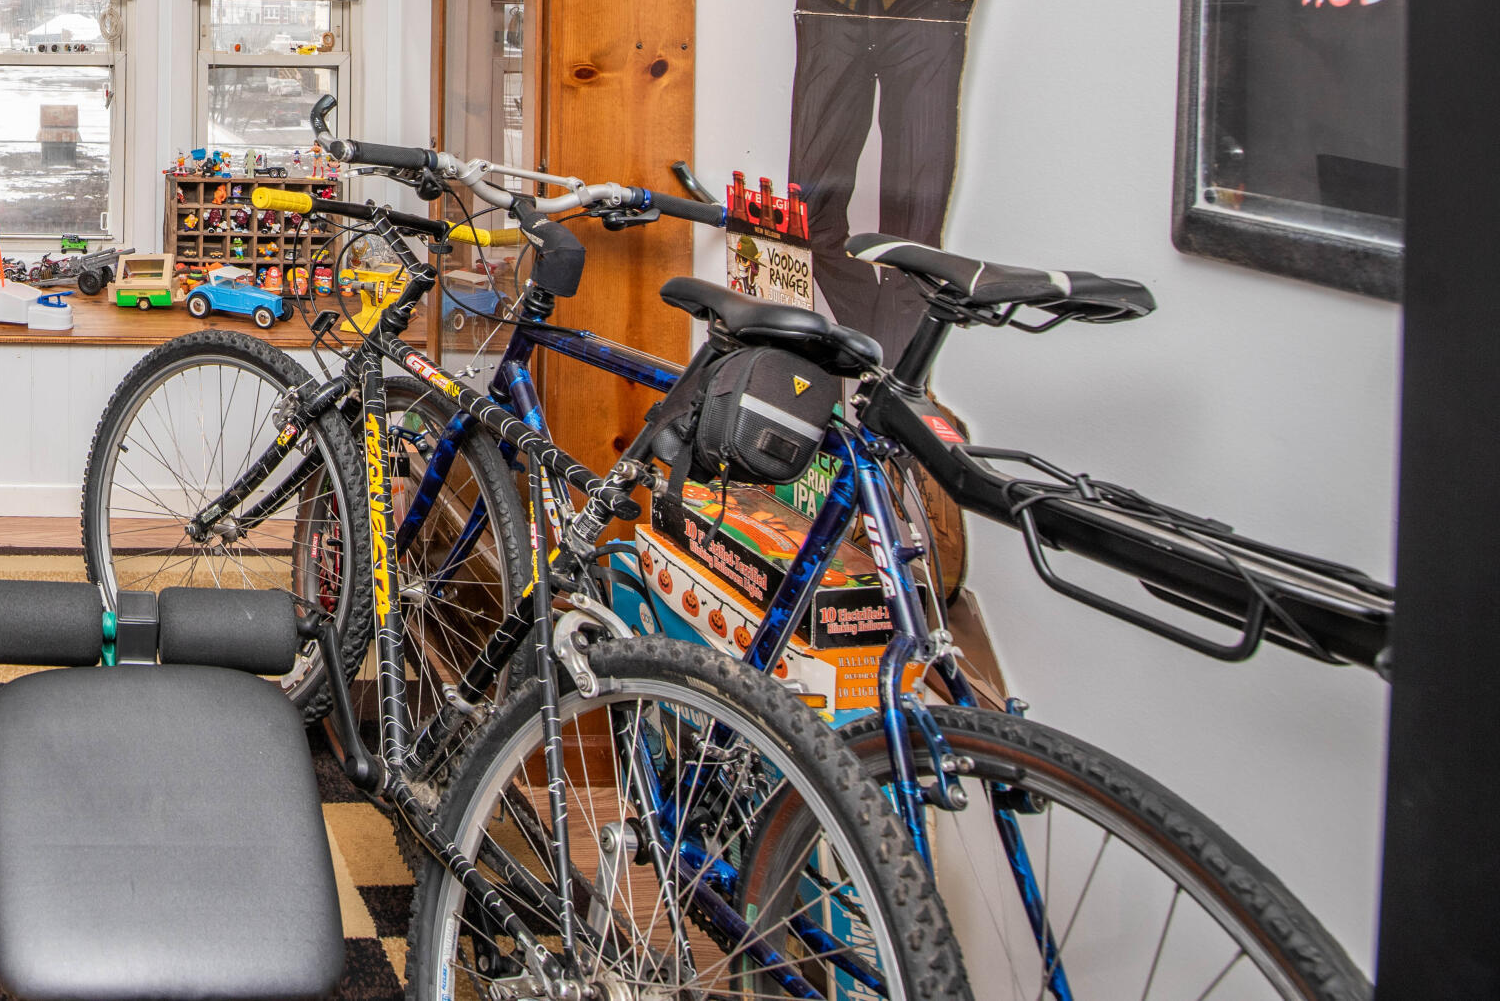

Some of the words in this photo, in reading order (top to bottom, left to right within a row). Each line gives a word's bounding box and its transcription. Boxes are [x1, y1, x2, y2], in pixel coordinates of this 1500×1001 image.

[767, 247, 809, 278] VOODOO
[769, 267, 810, 299] RANGER
[408, 355, 438, 380] GT
[793, 482, 817, 519] IPA
[365, 412, 391, 627] TEQUESTA
[684, 518, 698, 541] 10
[689, 538, 714, 569] Blinking
[863, 513, 897, 599] USA
[819, 606, 837, 624] 10
[827, 621, 858, 636] Blinking
[837, 655, 882, 668] HALLOWE
[837, 686, 851, 698] 10
[851, 685, 880, 698] LIGHT
